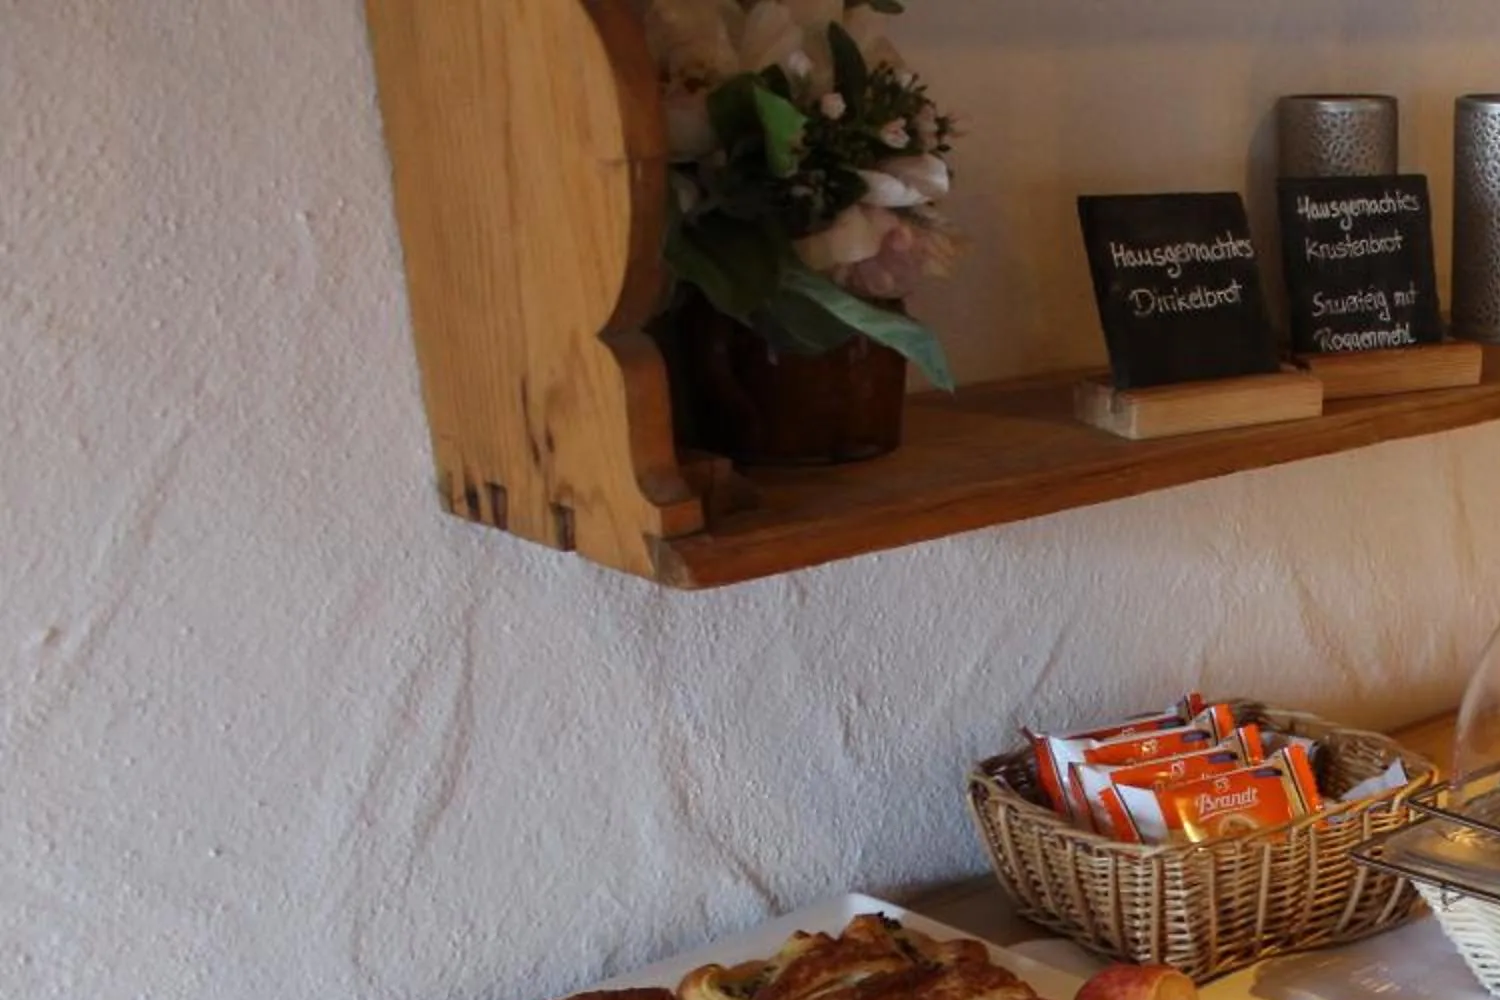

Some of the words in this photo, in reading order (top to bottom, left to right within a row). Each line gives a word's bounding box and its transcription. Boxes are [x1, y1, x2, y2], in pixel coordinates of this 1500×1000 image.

[1296, 191, 1420, 231] Hausgemachtes
[1109, 230, 1254, 279] Hausgemachtes
[1304, 229, 1403, 263] Krustenbrot
[1128, 279, 1243, 316] Dinkelbrot
[1313, 321, 1417, 352] Roggenmehl
[1196, 787, 1259, 815] Brandt
